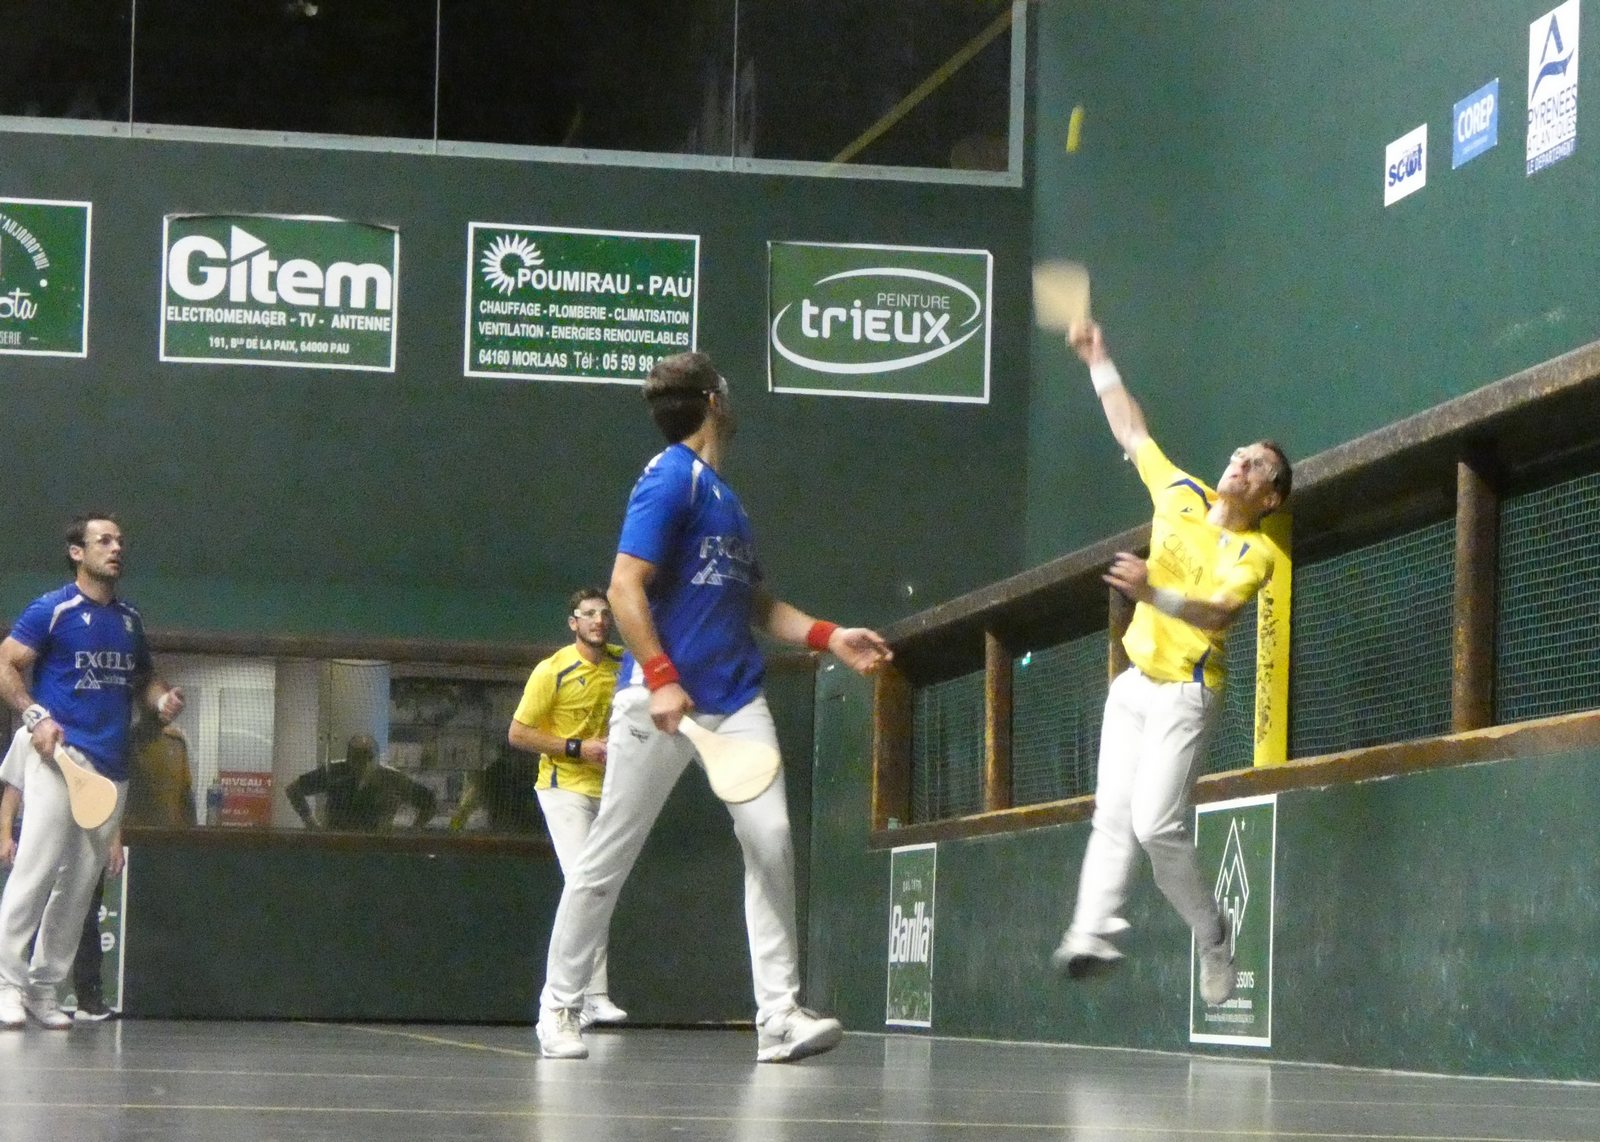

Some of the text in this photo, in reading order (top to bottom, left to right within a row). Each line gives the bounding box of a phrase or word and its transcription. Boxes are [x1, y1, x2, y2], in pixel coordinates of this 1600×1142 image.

[1457, 93, 1495, 143] COREP
[0, 212, 50, 271] 'AUJOURD'HUI
[168, 224, 392, 311] Gitem
[517, 268, 631, 295] POUMIRAU
[649, 275, 692, 297] PAU
[479, 300, 541, 317] CHAUFFAGE
[549, 304, 606, 320] PLOMBERIE
[614, 308, 689, 325] CLIMATISATION
[876, 292, 951, 310] PEINTURE
[167, 305, 287, 326] ELECTROMENAGER
[299, 312, 317, 327] TV
[331, 314, 391, 332] ANTENNE
[260, 339, 272, 351] LA
[300, 340, 329, 353] 64000
[330, 342, 350, 354] PAU
[478, 321, 544, 337] VENTILATION
[551, 326, 601, 342] ENERGIES
[603, 328, 690, 346] RENOUVELABLES
[479, 348, 510, 365] 64160
[512, 350, 567, 368] MORLAAS
[602, 353, 618, 370] 05
[620, 355, 636, 371] 59
[638, 356, 654, 373] 98
[890, 901, 930, 963] Barilla
